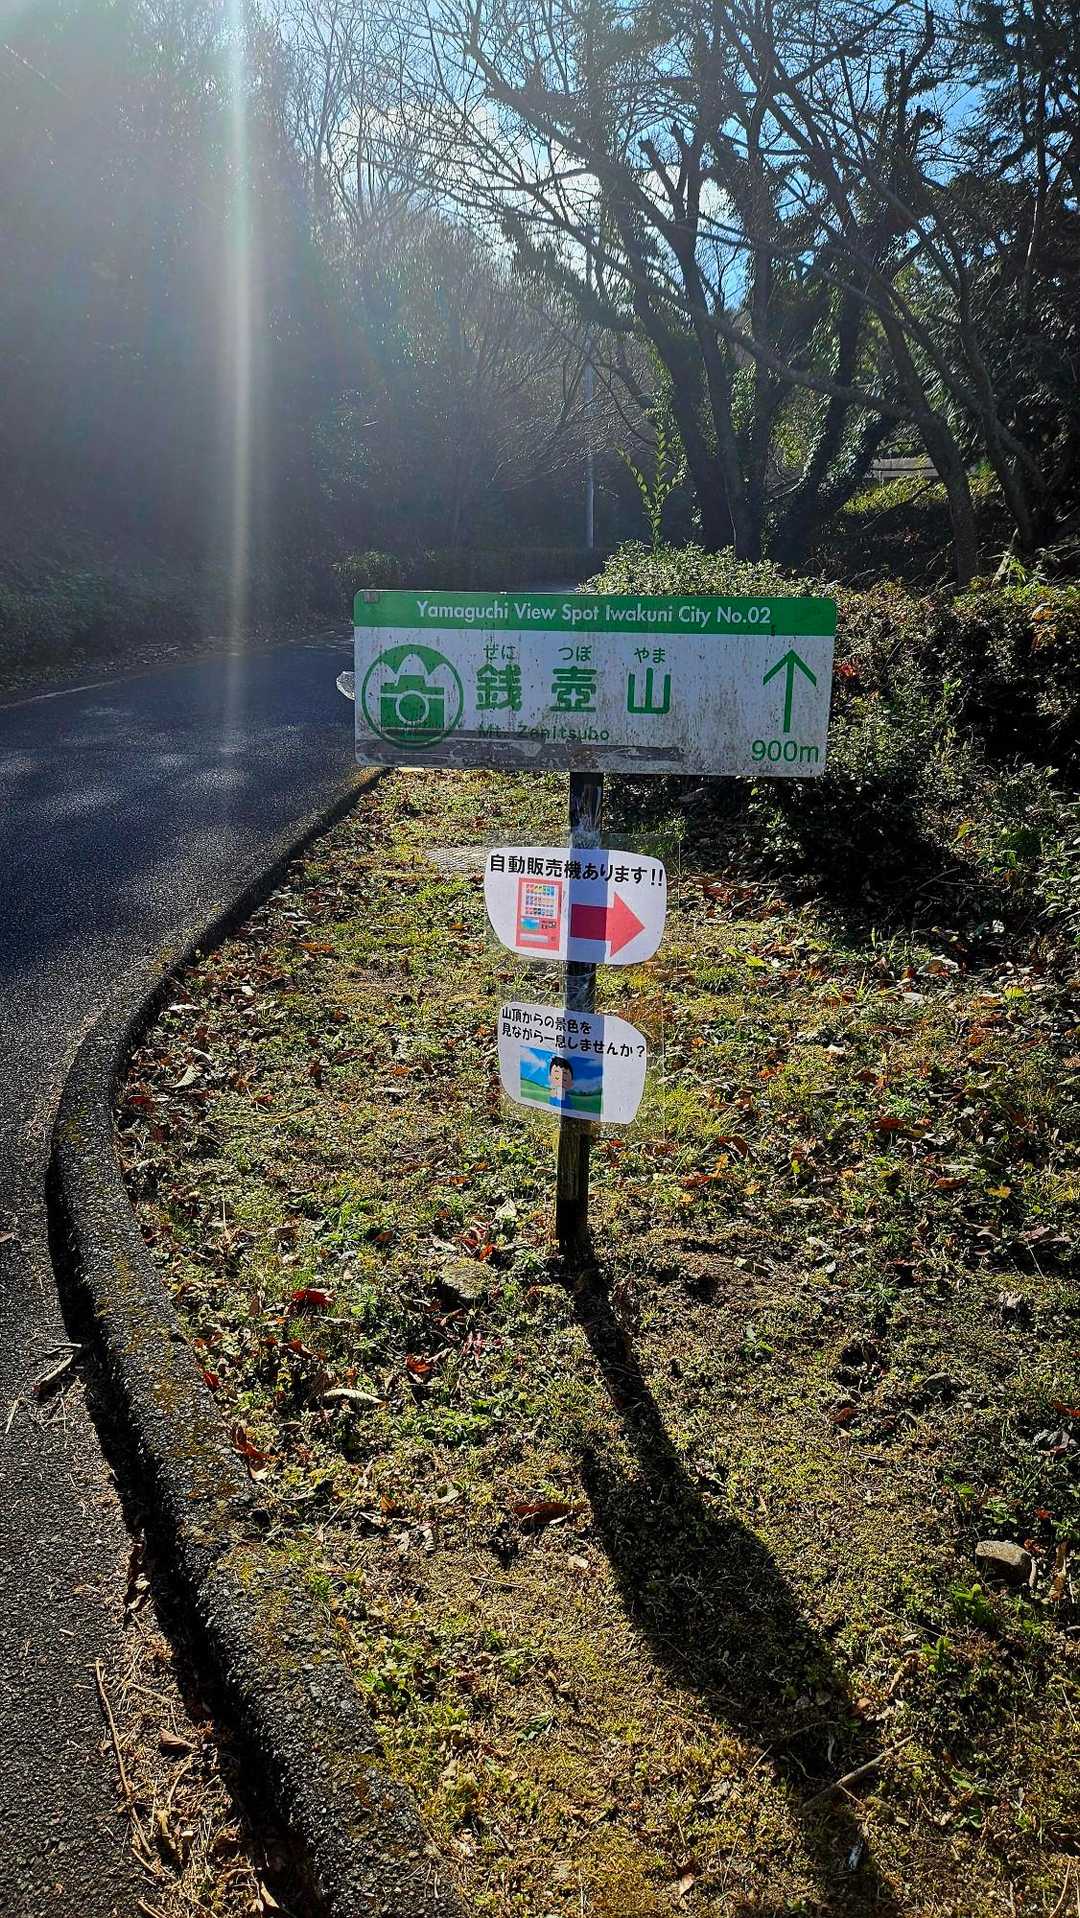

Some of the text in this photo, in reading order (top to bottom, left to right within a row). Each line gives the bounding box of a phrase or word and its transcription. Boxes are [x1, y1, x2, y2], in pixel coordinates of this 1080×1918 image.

[416, 600, 771, 628] Yamaguchi View Spot Iwakuni City No.02
[517, 725, 610, 741] Zenitsubo
[750, 739, 819, 763] 900m
[501, 1007, 592, 1035] 山頂からの景色を
